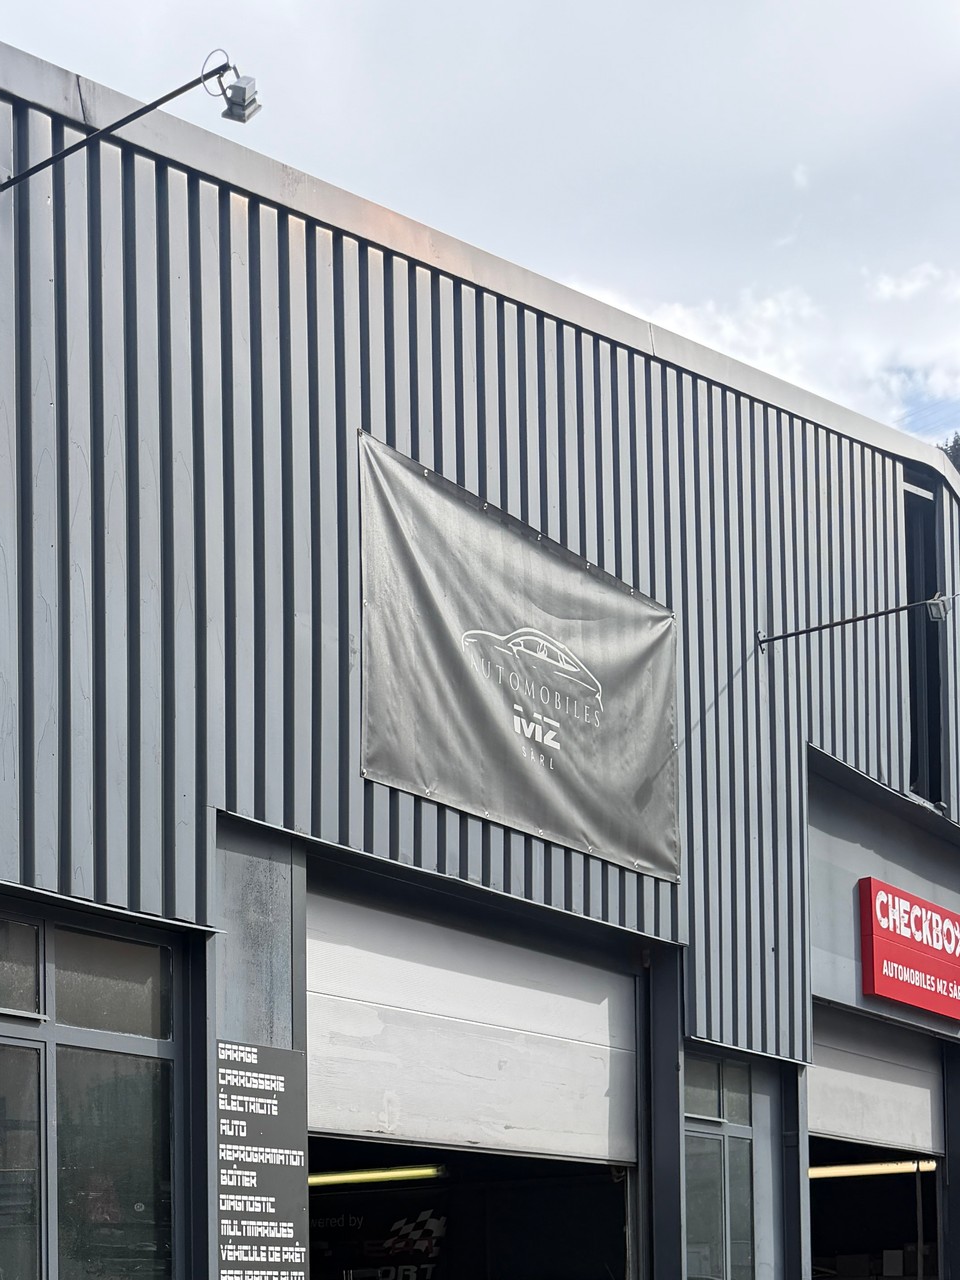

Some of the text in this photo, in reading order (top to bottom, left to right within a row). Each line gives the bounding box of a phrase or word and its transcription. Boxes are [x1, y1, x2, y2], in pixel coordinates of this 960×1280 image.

[470, 654, 600, 728] AUTOMOBILES
[513, 703, 561, 750] MZ
[875, 890, 960, 958] CHECKBOX
[882, 959, 935, 992] AUTOMOBILES
[936, 977, 948, 996] MZ
[218, 1042, 258, 1064] GARAGE
[218, 1067, 285, 1092] CARROSSERIE
[218, 1087, 278, 1116] ÉLECTRICITÉ
[220, 1118, 247, 1137] AUTO
[219, 1194, 276, 1213] DIAGNOSTIC
[221, 1219, 294, 1238] MULTIMARQUES
[310, 1213, 364, 1229] wered by
[220, 1238, 306, 1263] VÉHICULE DE PRÊT
